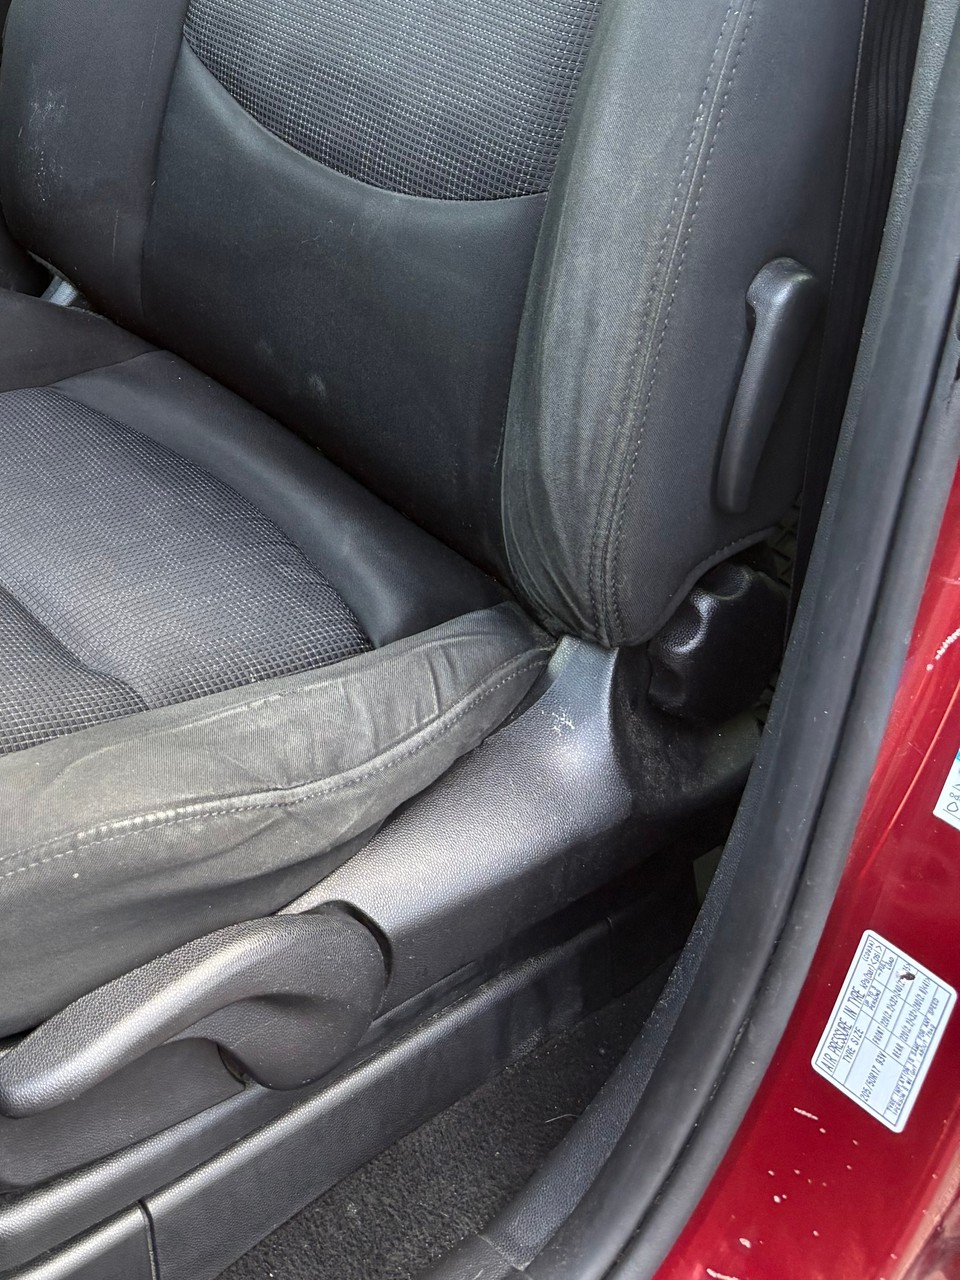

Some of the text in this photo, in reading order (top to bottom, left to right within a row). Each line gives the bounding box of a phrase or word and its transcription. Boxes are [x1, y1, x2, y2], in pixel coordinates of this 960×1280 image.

[846, 985, 865, 1010] TYRE
[927, 996, 939, 1016] SPEED
[842, 1004, 857, 1020] IN
[827, 1016, 852, 1057] PRESSURE
[842, 1025, 863, 1064] TYRE SIZE
[872, 1025, 885, 1045] FRONT
[891, 1041, 904, 1059] REAR
[820, 1051, 837, 1072] AIR
[859, 1064, 880, 1102] 205/50R17
